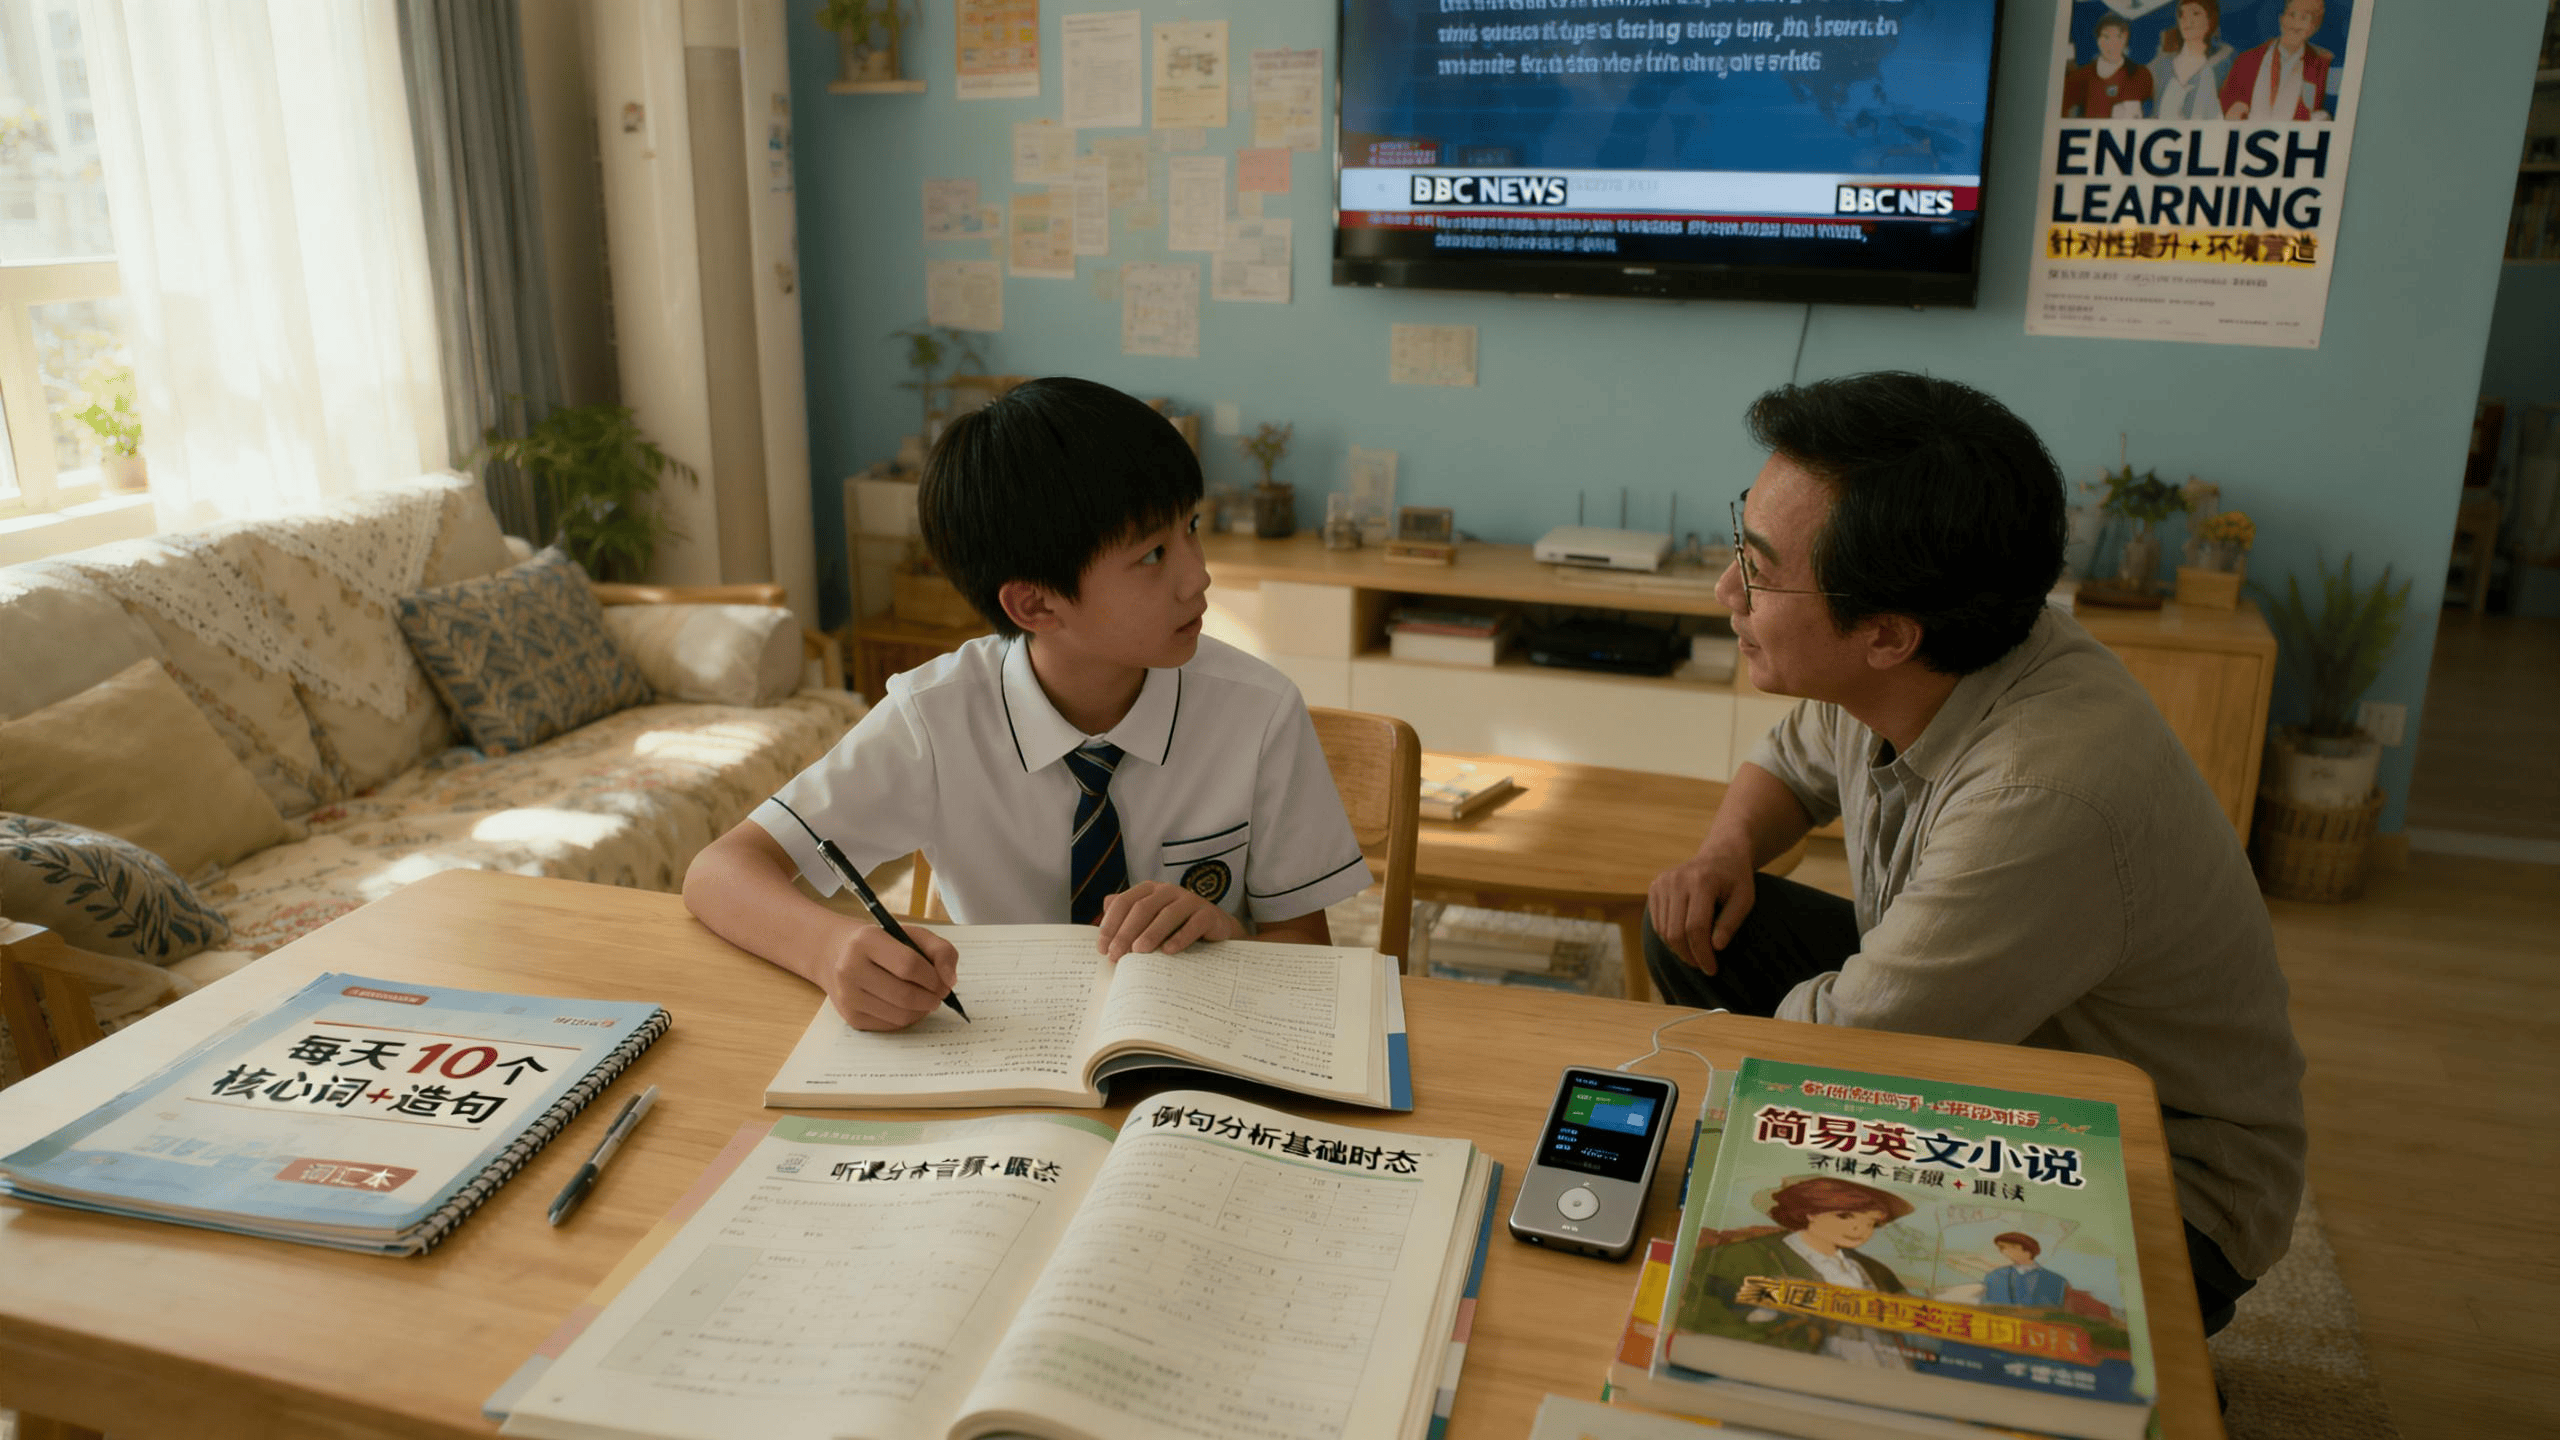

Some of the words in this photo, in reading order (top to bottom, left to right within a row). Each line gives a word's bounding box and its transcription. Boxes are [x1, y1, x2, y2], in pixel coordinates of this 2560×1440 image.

[2056, 128, 2331, 179] ENGLISH
[1413, 176, 1474, 204] BBC
[1479, 176, 1566, 205] NEWS
[1838, 186, 1896, 213] BBC
[1899, 188, 1954, 215] NES
[2052, 183, 2323, 229] LEARNING
[1151, 1105, 1422, 1174] 例句分析基础时态
[1755, 1106, 2084, 1188] 简易英文小说
